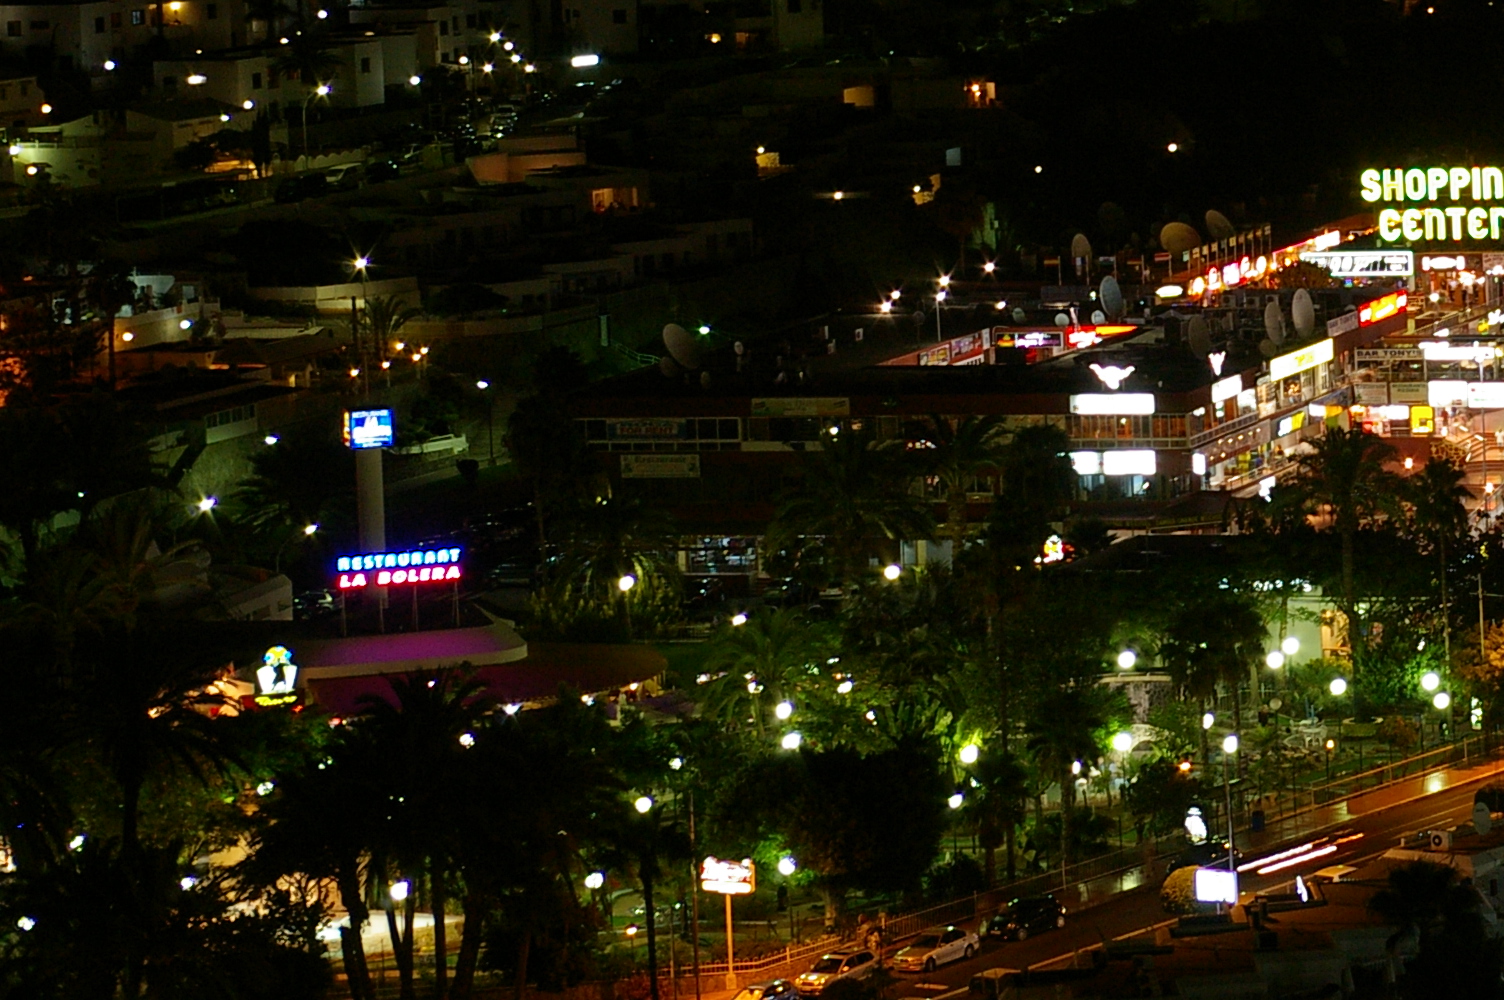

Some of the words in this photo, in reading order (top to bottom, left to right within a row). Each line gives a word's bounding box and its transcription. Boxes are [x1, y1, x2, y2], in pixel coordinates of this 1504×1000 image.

[337, 548, 461, 572] RESTAURANT
[339, 573, 367, 588] LA
[377, 566, 461, 585] BOLERA
